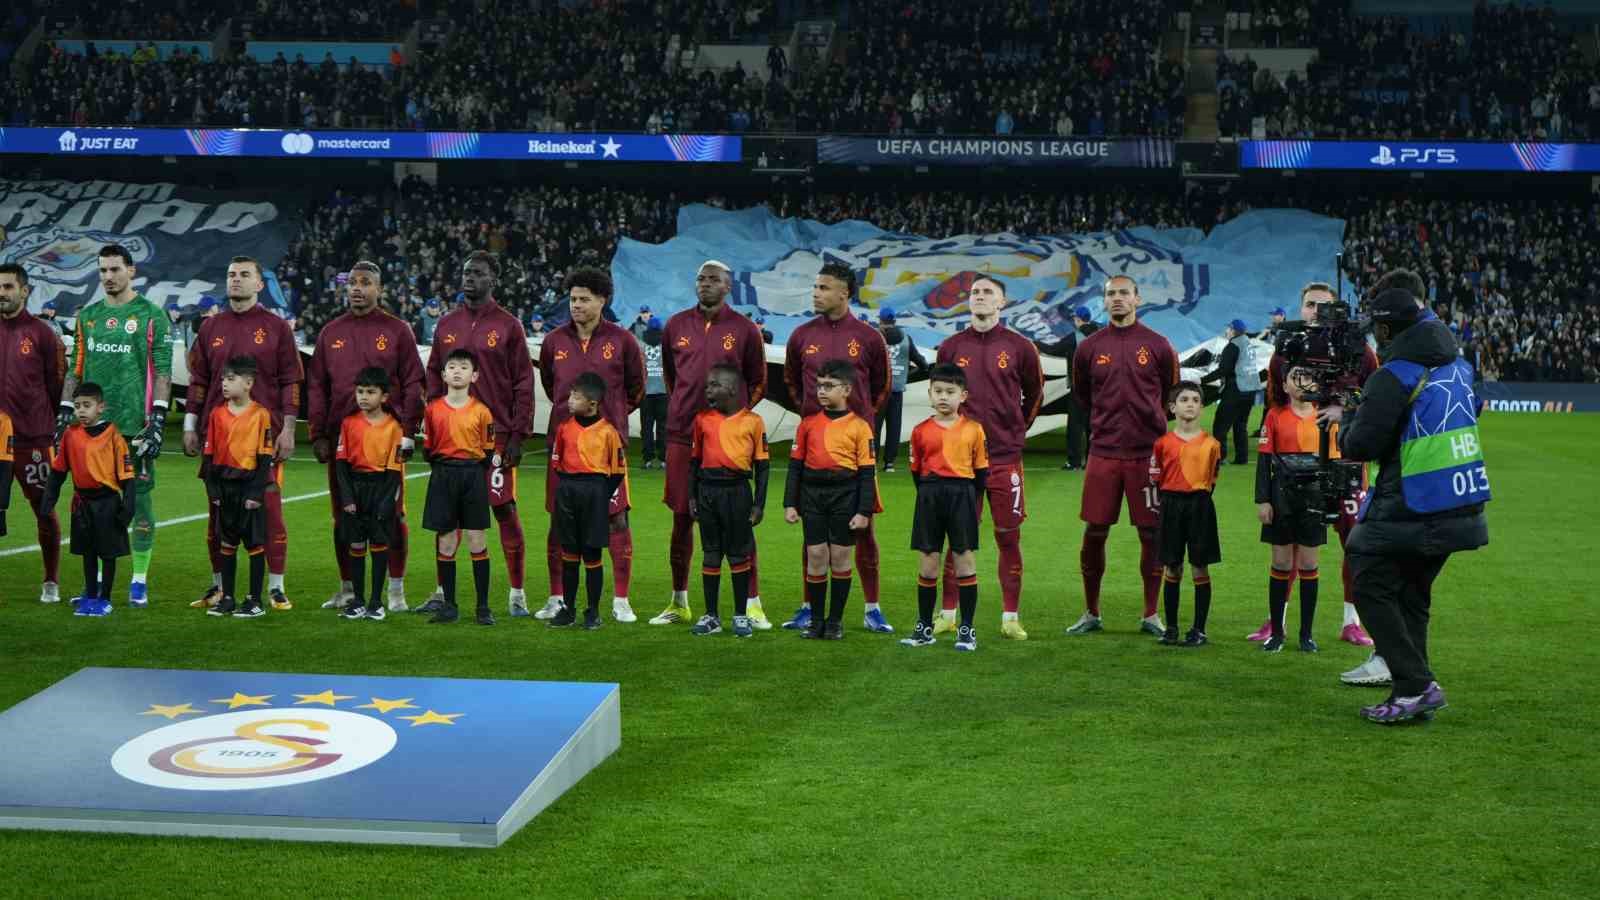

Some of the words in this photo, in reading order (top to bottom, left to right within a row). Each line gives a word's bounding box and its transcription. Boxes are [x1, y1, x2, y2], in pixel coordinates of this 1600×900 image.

[80, 137, 112, 150] JUST
[113, 138, 139, 150] EAT
[318, 138, 390, 150] mastercard
[528, 139, 596, 154] Heineken
[877, 139, 922, 154] UEFA
[928, 140, 1033, 156] CHAMPIONS
[1041, 142, 1109, 157] LEAGUE
[1400, 148, 1458, 163] PS5
[95, 343, 132, 353] SOCAR
[1450, 432, 1479, 459] HB
[25, 462, 50, 484] 20
[491, 467, 504, 489] 6
[1452, 466, 1490, 496] 013
[1011, 485, 1021, 508] 7
